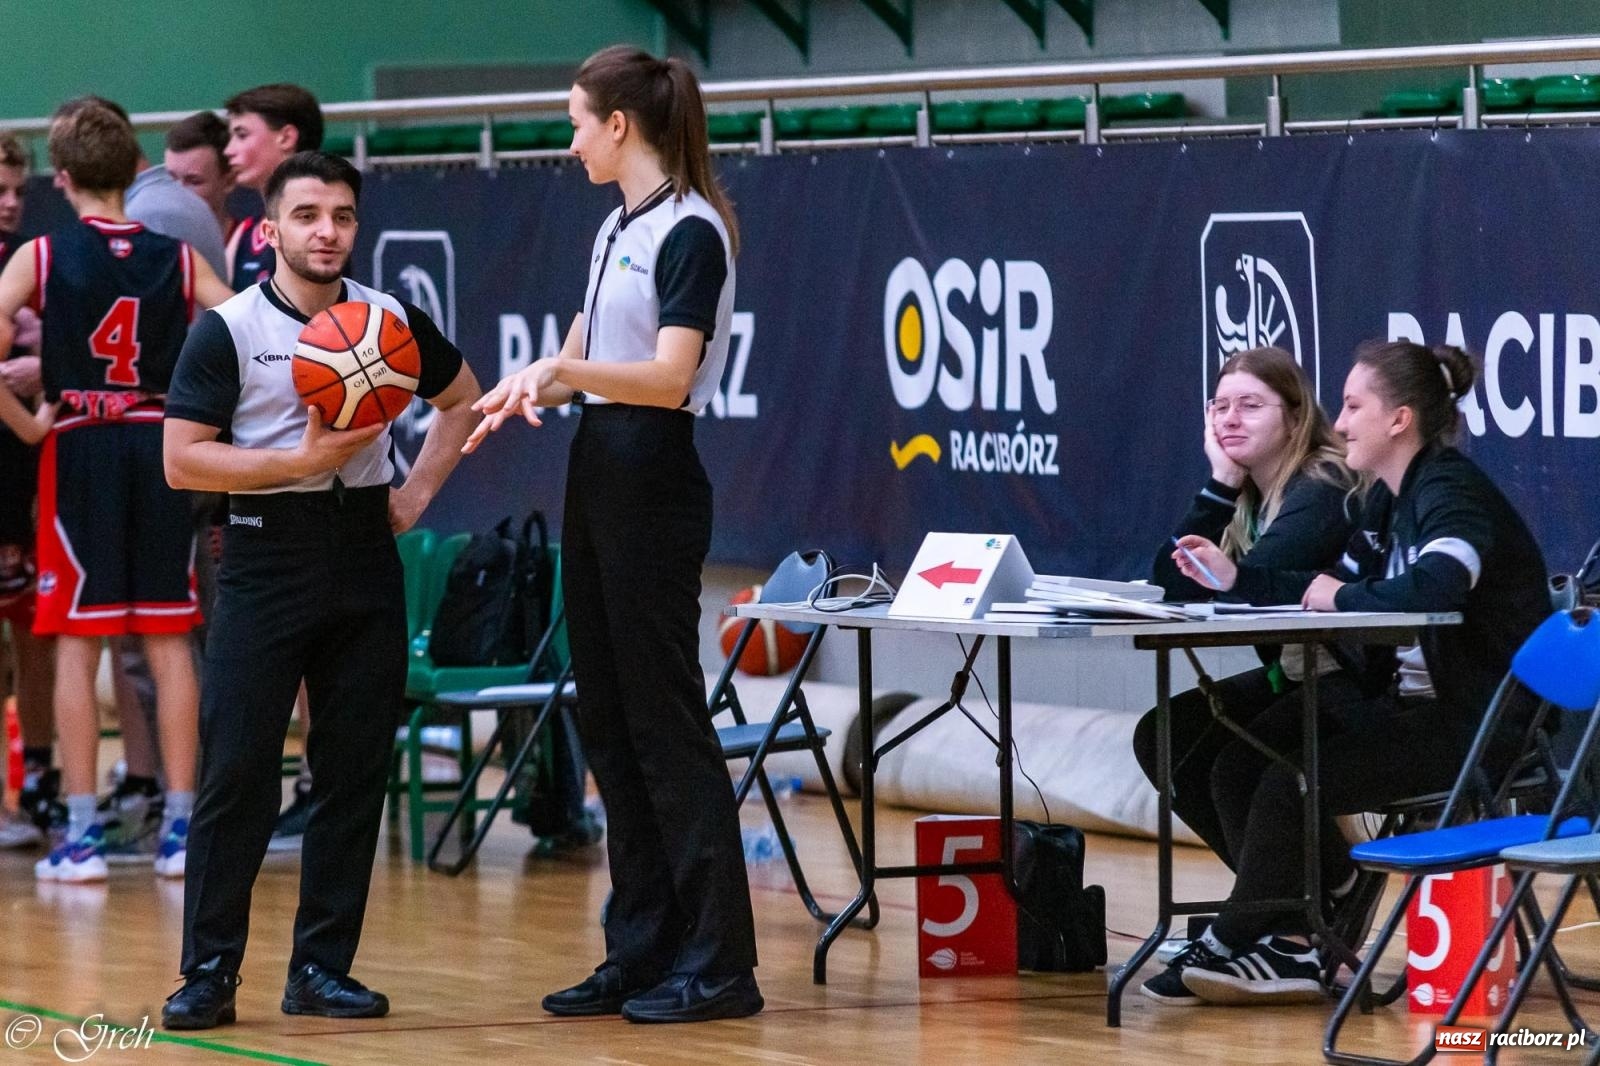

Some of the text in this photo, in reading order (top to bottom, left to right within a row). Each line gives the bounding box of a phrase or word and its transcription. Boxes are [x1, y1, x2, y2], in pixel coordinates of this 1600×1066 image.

[89, 297, 141, 387] 4
[949, 419, 1060, 475] RACIBÓRZ
[921, 835, 984, 937] 5
[1407, 872, 1454, 971] 5
